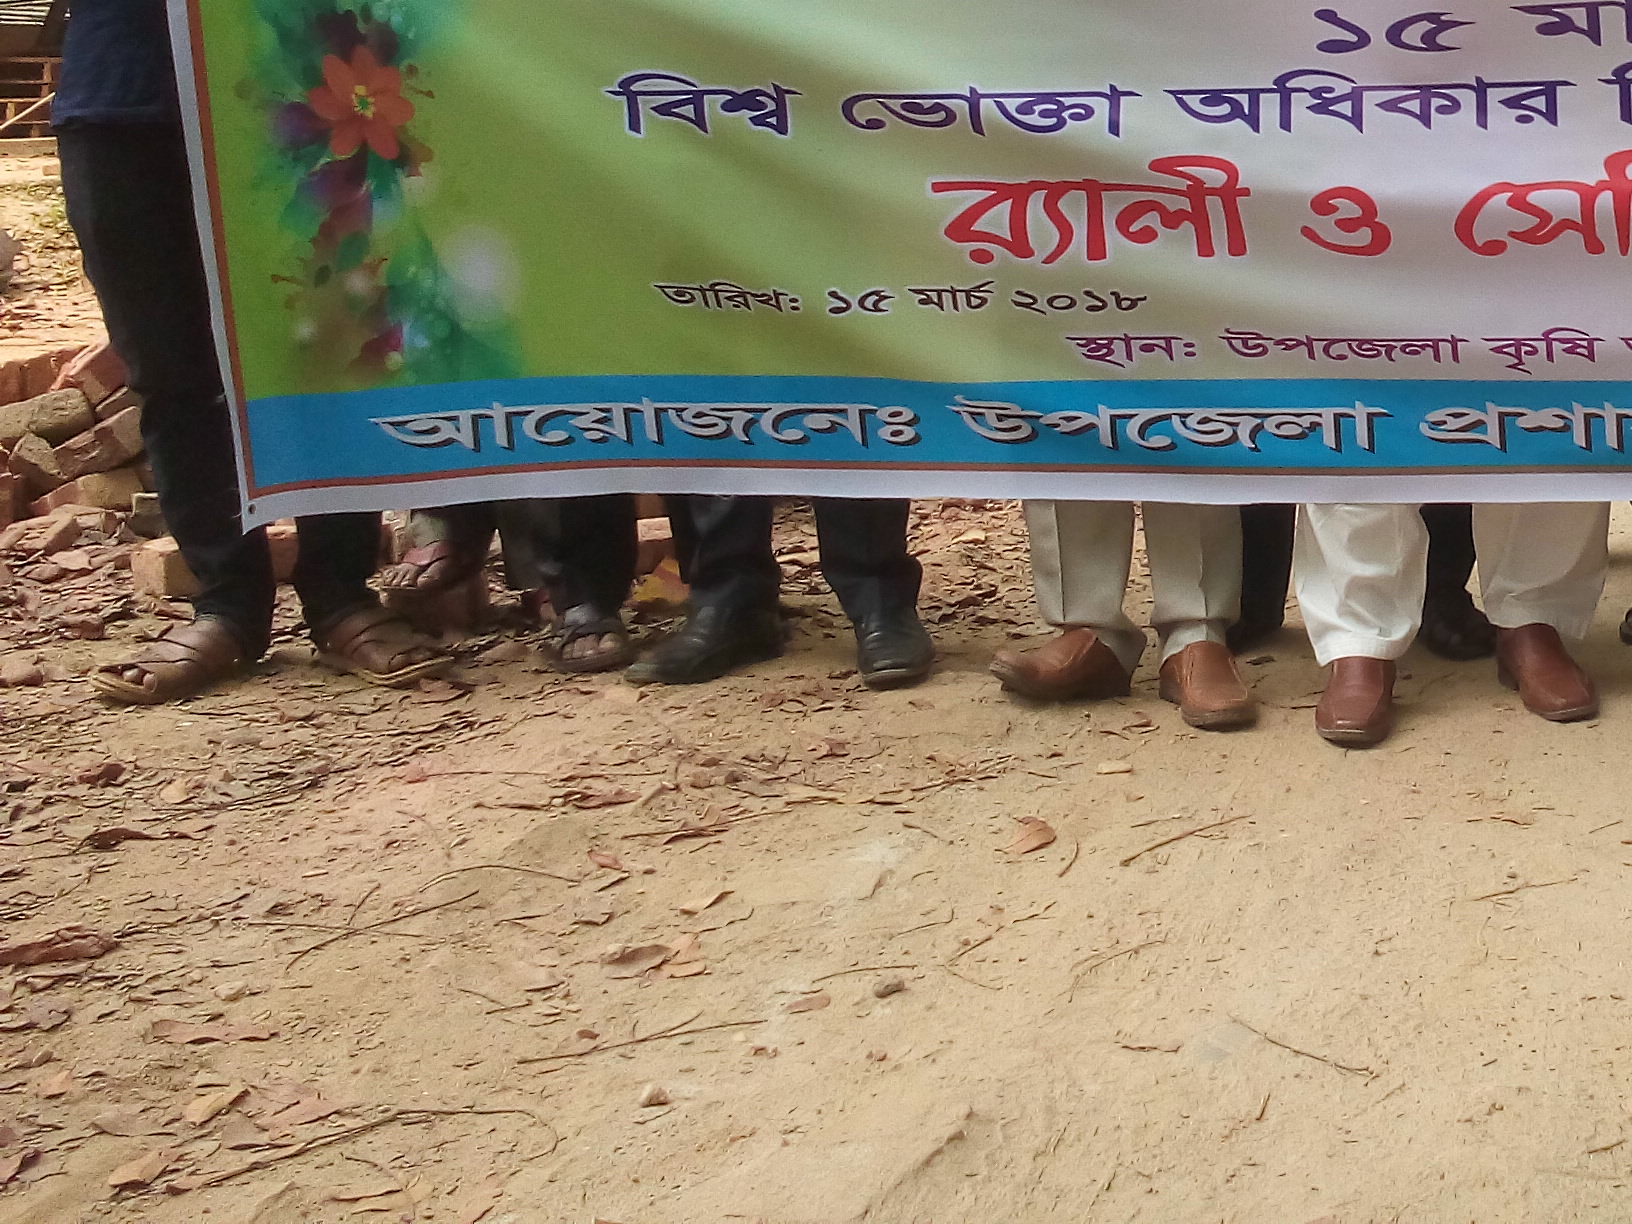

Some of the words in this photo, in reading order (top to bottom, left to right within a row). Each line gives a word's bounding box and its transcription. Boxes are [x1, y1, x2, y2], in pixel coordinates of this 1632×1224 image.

[1314, 7, 1476, 54] ১৫
[606, 71, 802, 140] বিশ্ব
[841, 83, 1141, 139] ভোক্তা
[1163, 69, 1578, 135] অধিকার
[1300, 186, 1393, 257] ও
[655, 281, 801, 313] তারিখ:
[826, 290, 896, 316] ১৫
[907, 282, 994, 312] মার্চ
[1010, 287, 1147, 315] ২০১৮
[1066, 333, 1196, 368] স্থান:
[1219, 326, 1468, 366] উপজেলা
[1481, 326, 1605, 374] কৃষি
[945, 394, 1401, 453] উপজেলা
